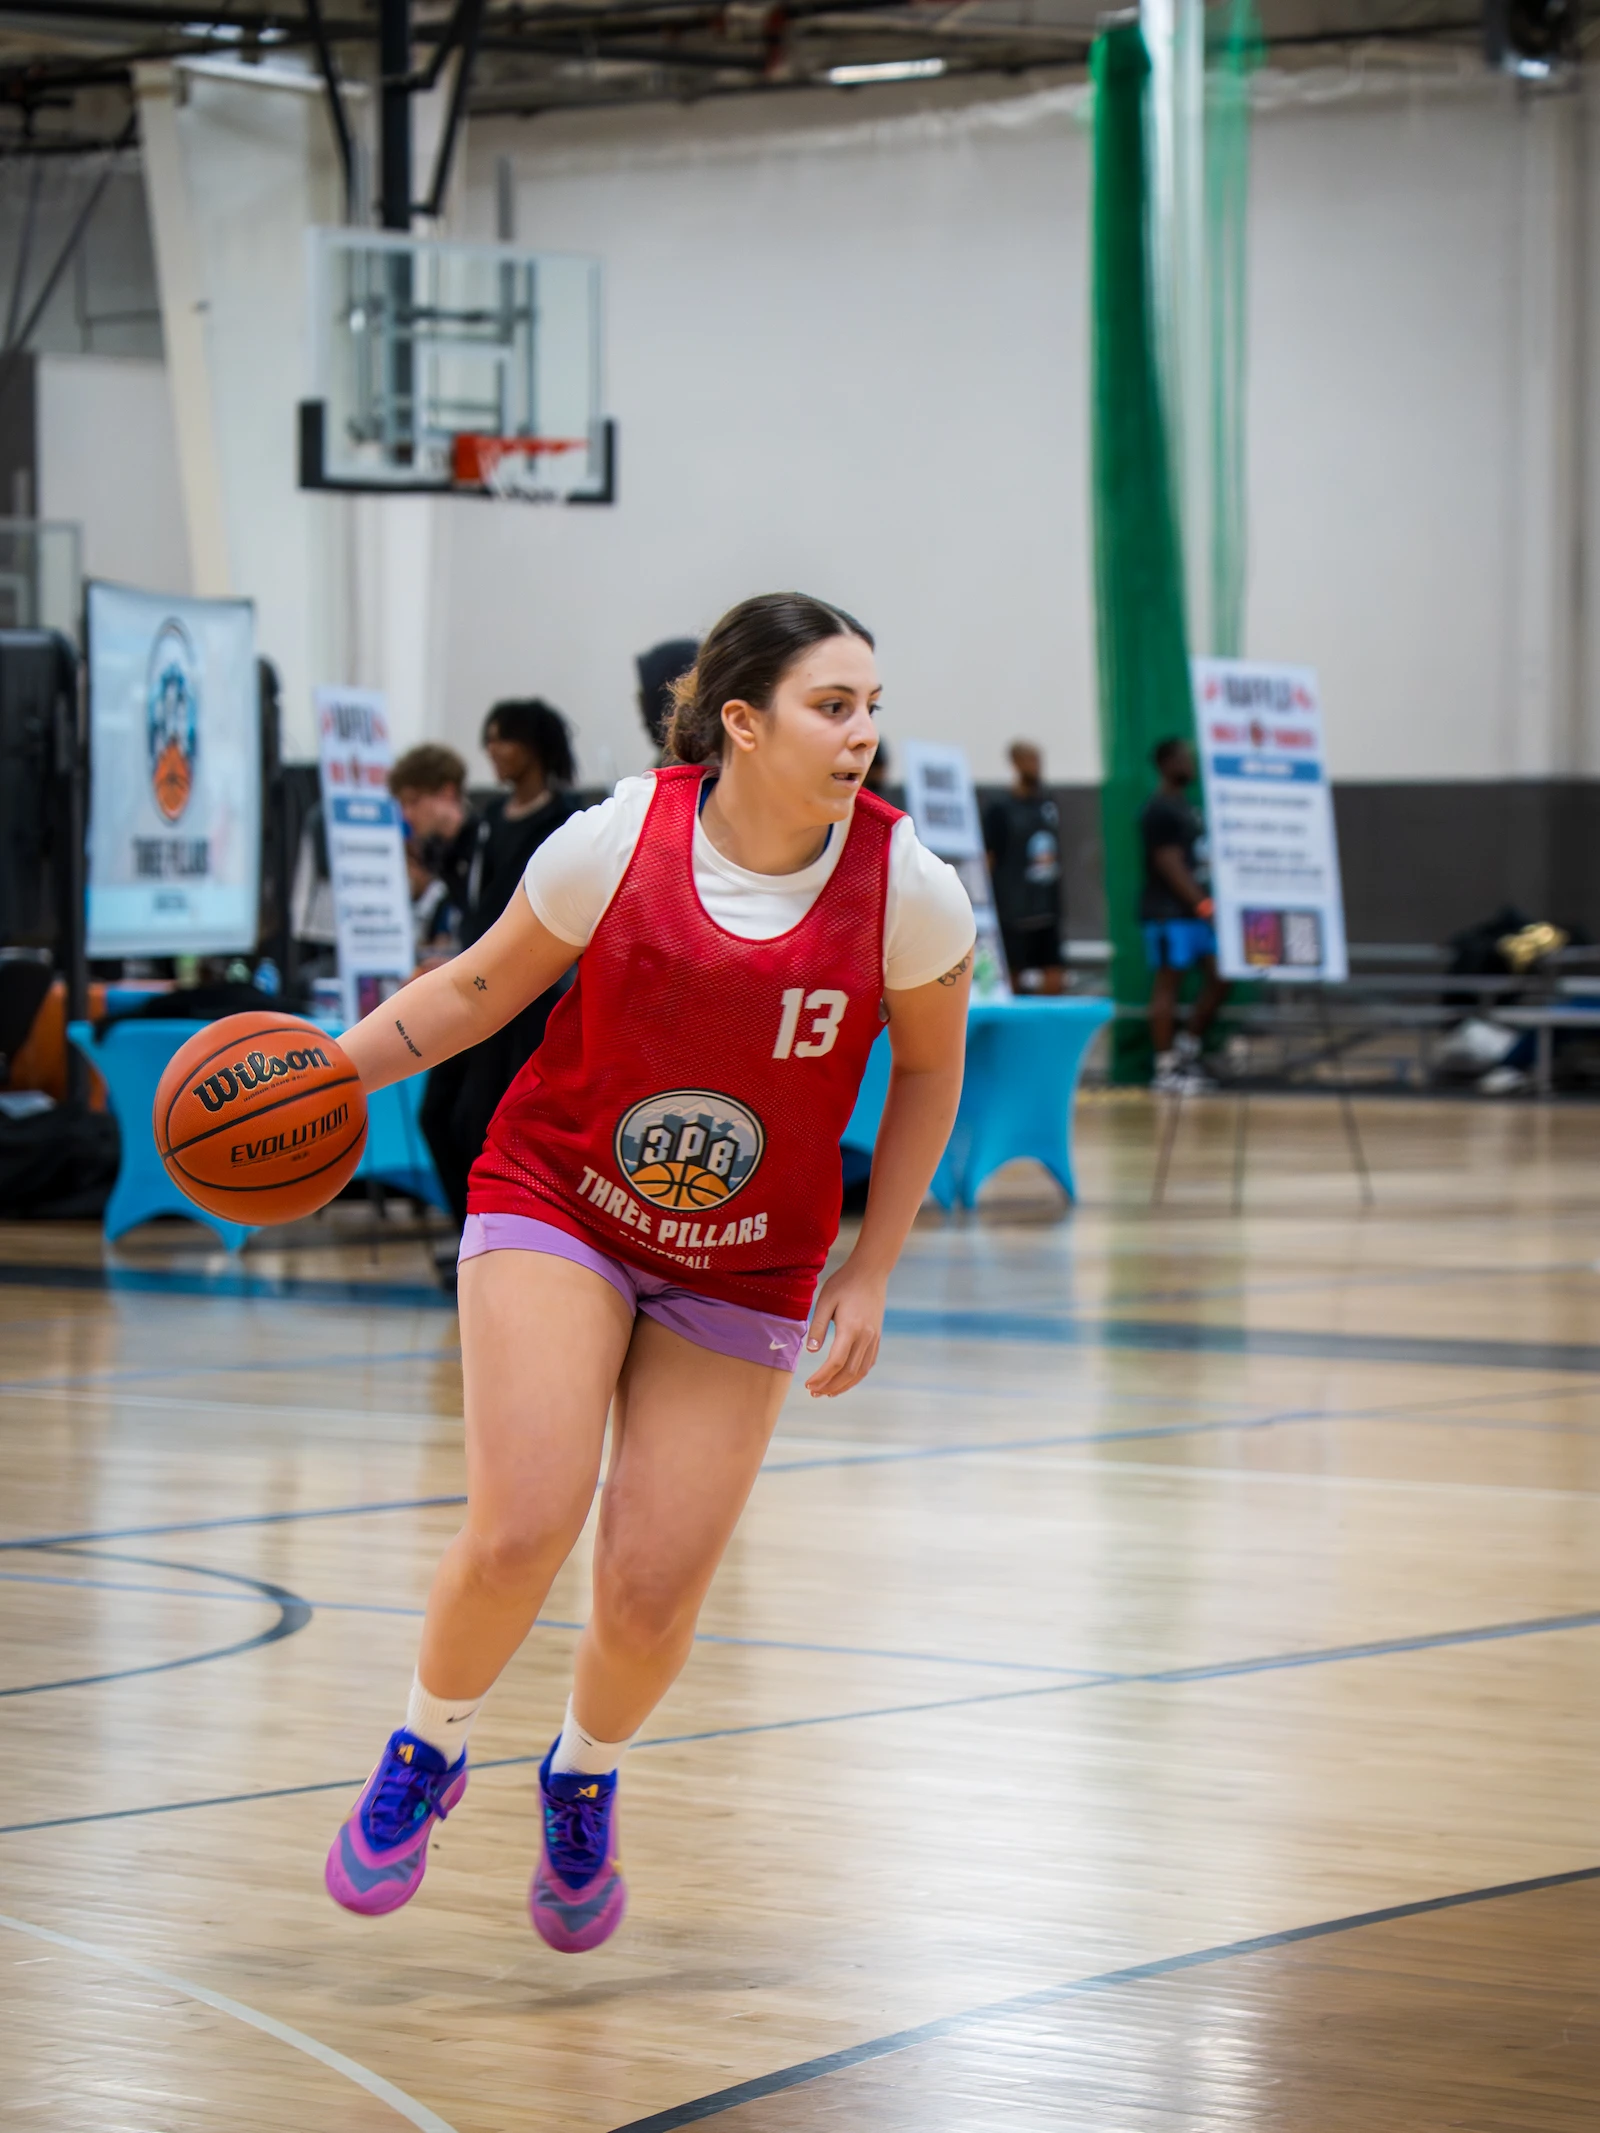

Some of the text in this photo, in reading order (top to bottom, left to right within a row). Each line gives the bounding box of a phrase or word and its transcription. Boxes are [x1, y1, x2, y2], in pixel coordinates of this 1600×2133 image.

[772, 987, 850, 1060] 13
[192, 1046, 332, 1114] Wilson
[230, 1101, 349, 1163] EVOLUTION
[642, 1124, 736, 1178] 3PB
[576, 1165, 769, 1249] THREE PILLARS
